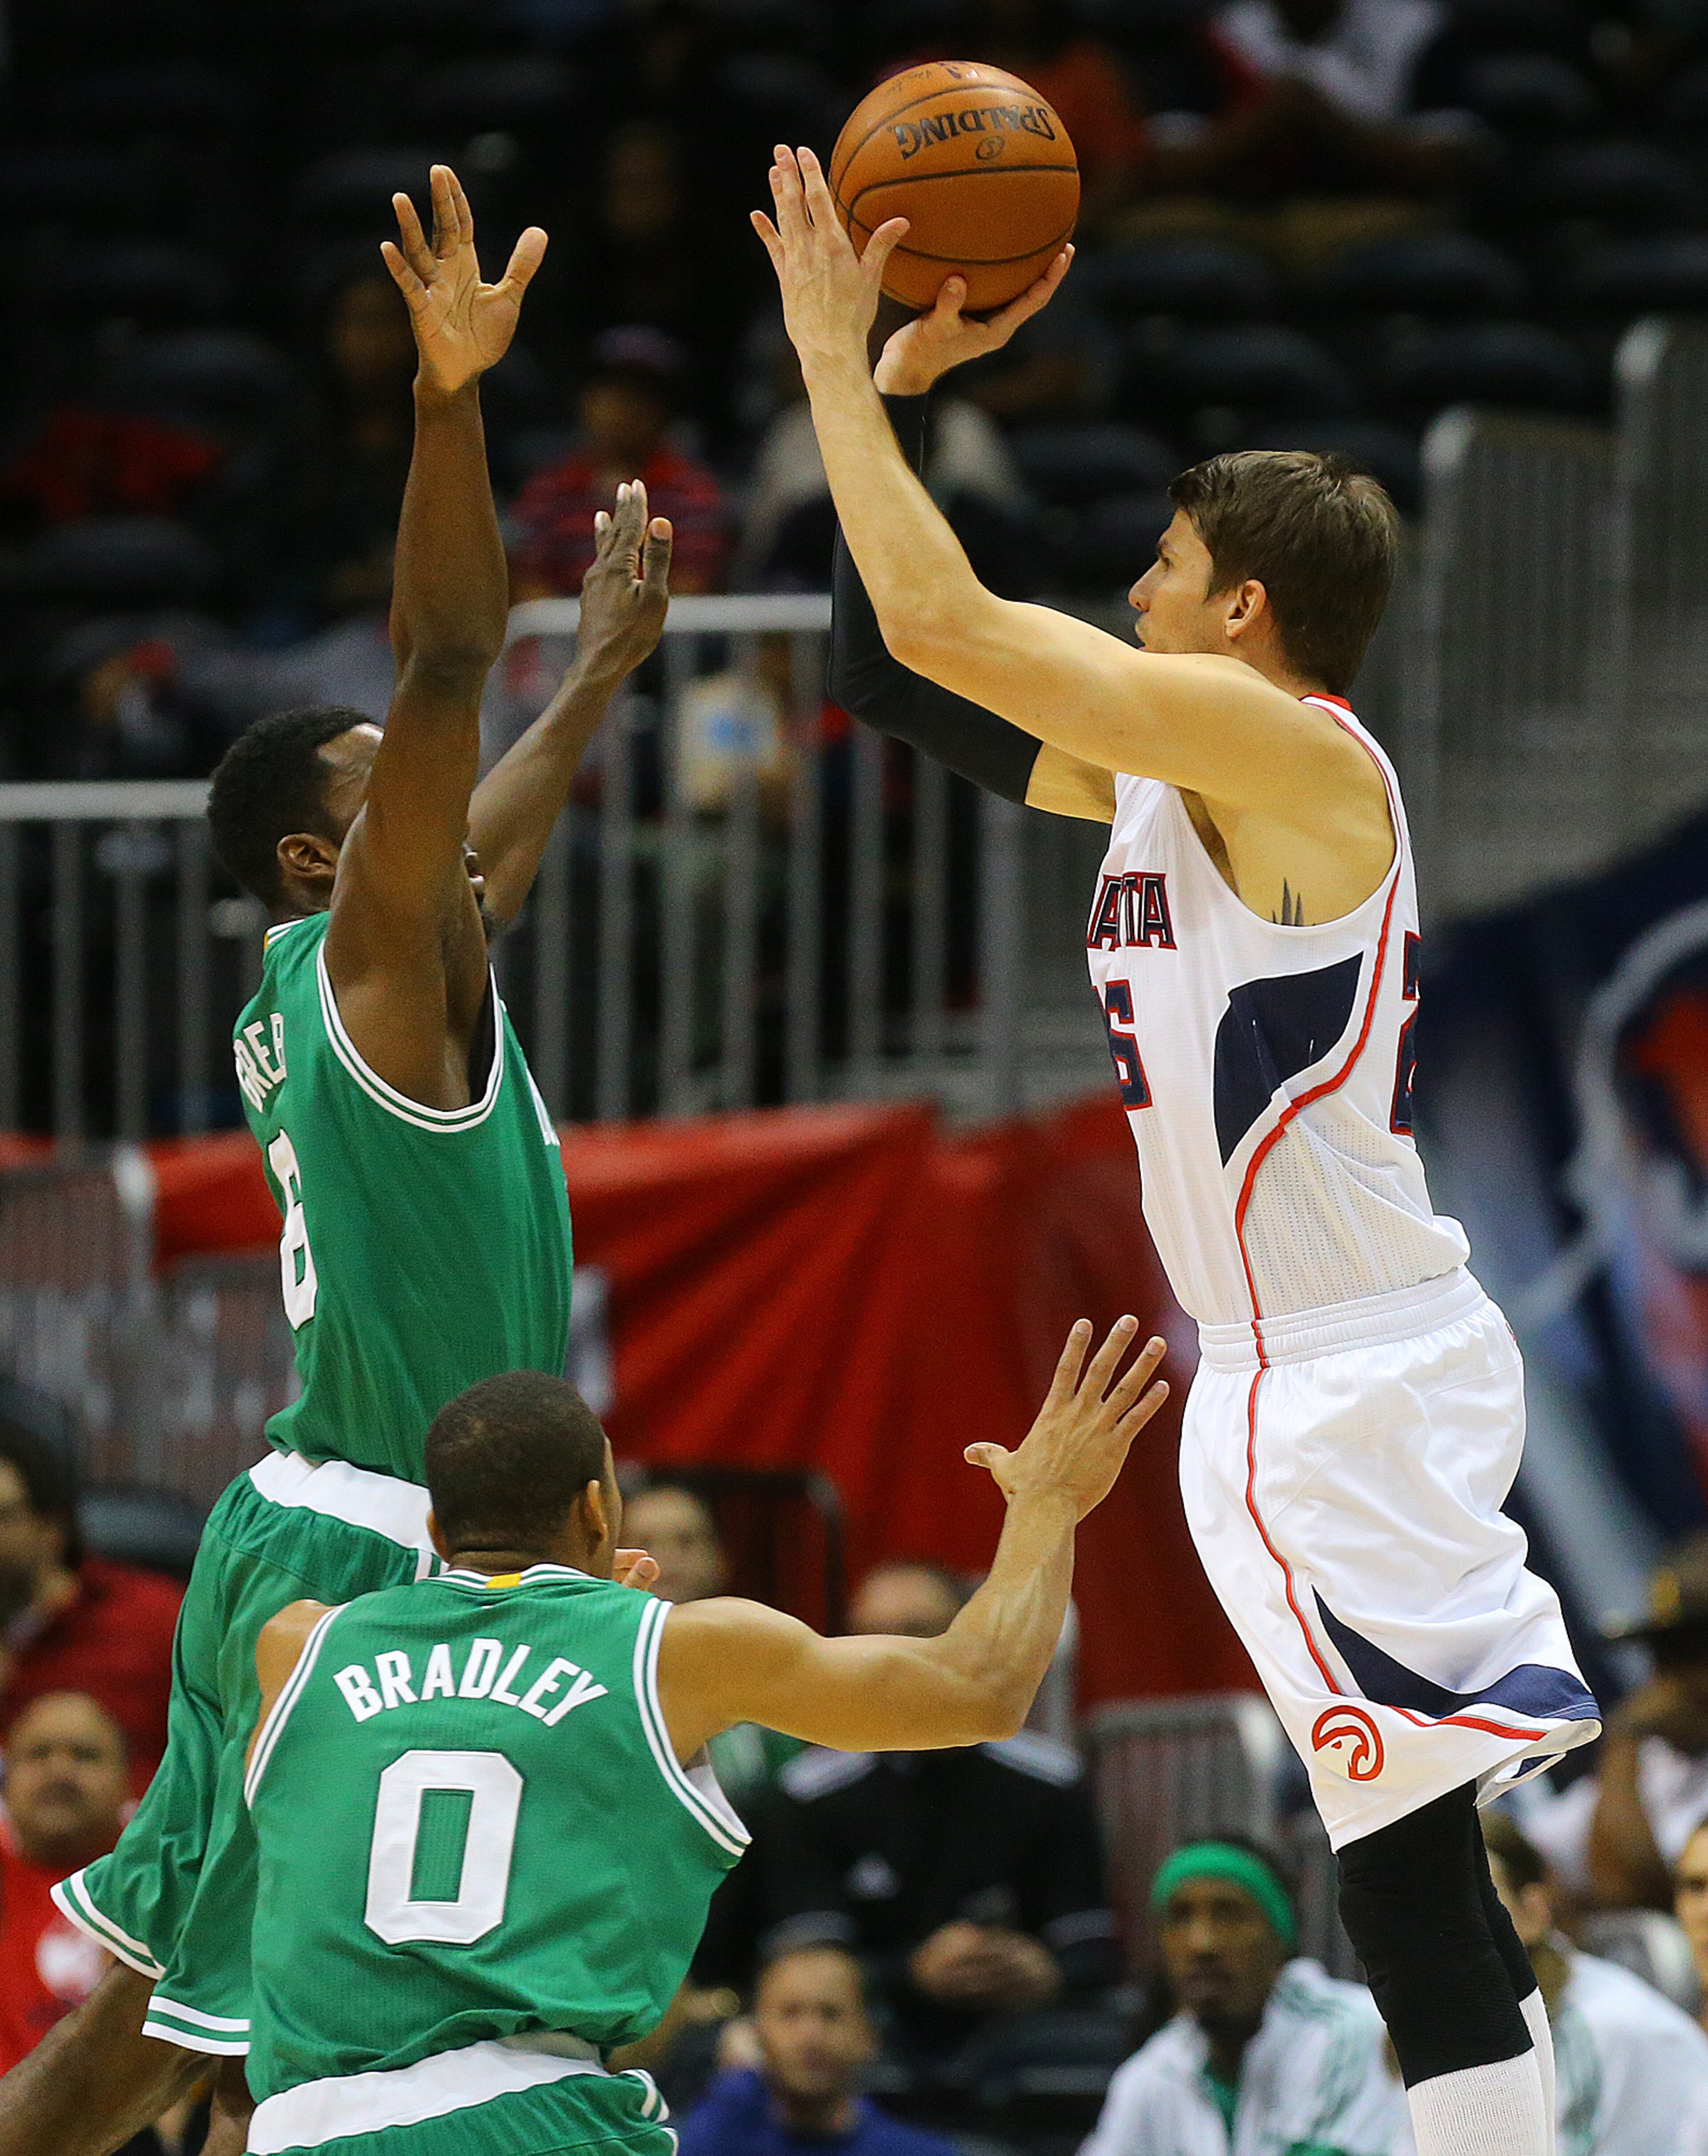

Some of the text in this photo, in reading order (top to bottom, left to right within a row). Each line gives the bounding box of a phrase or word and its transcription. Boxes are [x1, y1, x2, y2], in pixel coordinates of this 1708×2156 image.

[893, 105, 1055, 160] SPALDING
[332, 1637, 609, 1727] BRADLEY
[364, 1749, 524, 1945] 0
